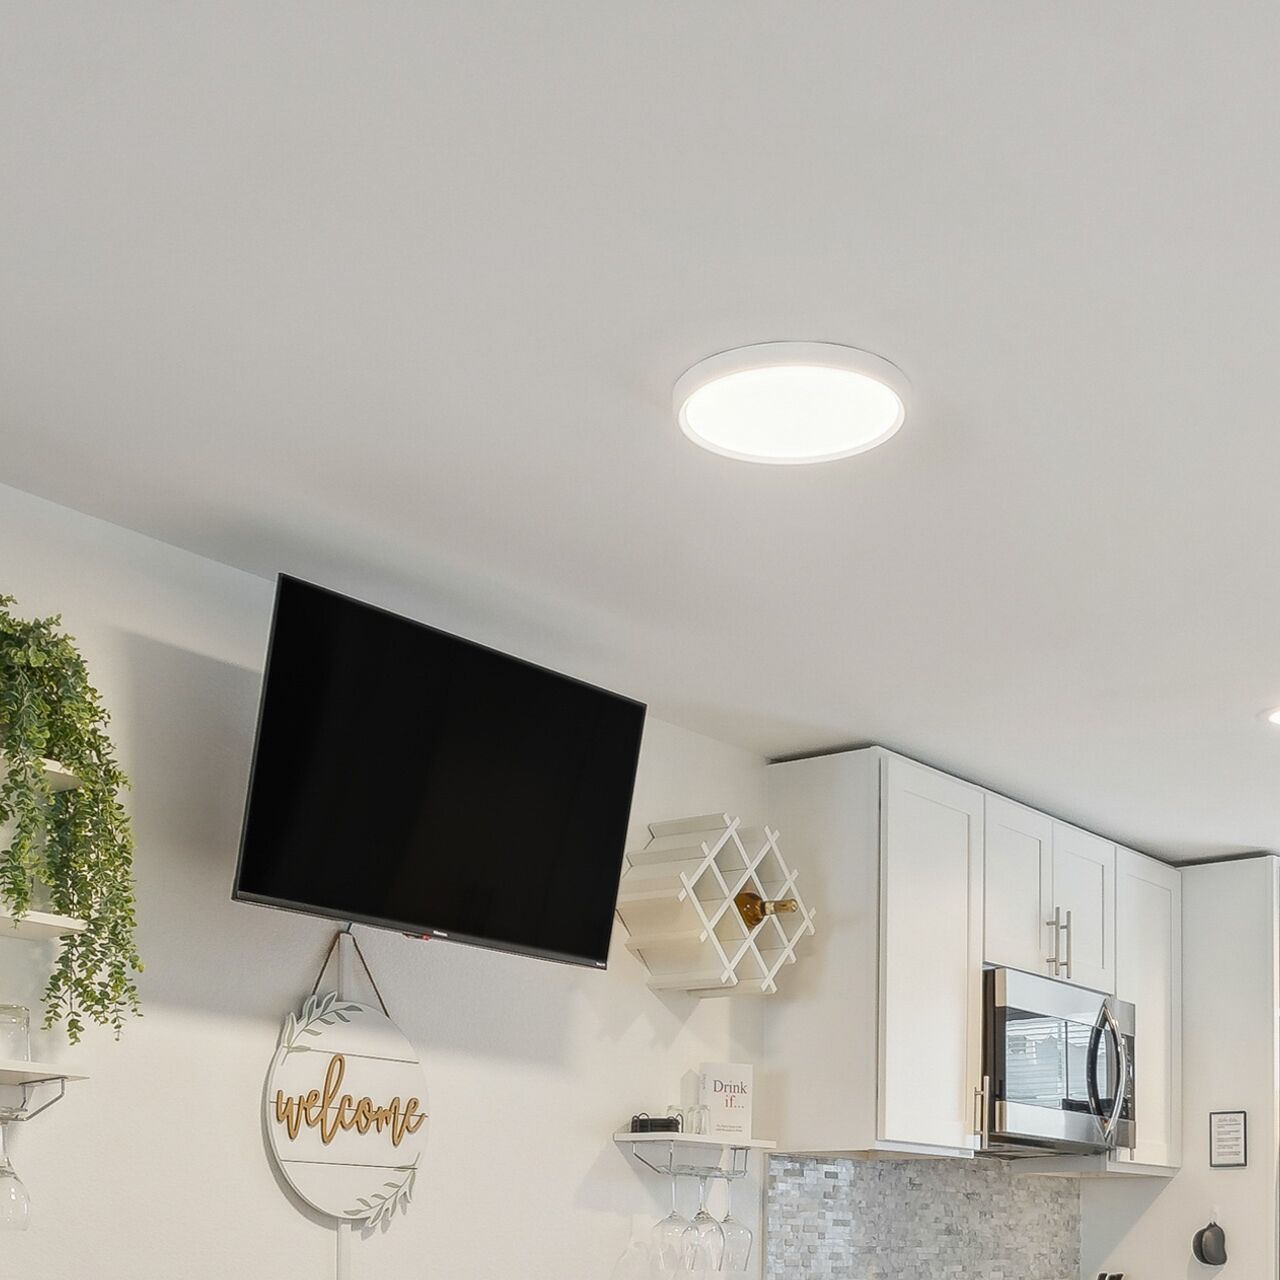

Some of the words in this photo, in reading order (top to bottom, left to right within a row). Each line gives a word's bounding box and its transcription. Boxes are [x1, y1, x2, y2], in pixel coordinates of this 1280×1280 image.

[713, 1079, 748, 1095] Drink
[276, 1053, 426, 1146] welcome
[725, 1095, 744, 1109] if...
